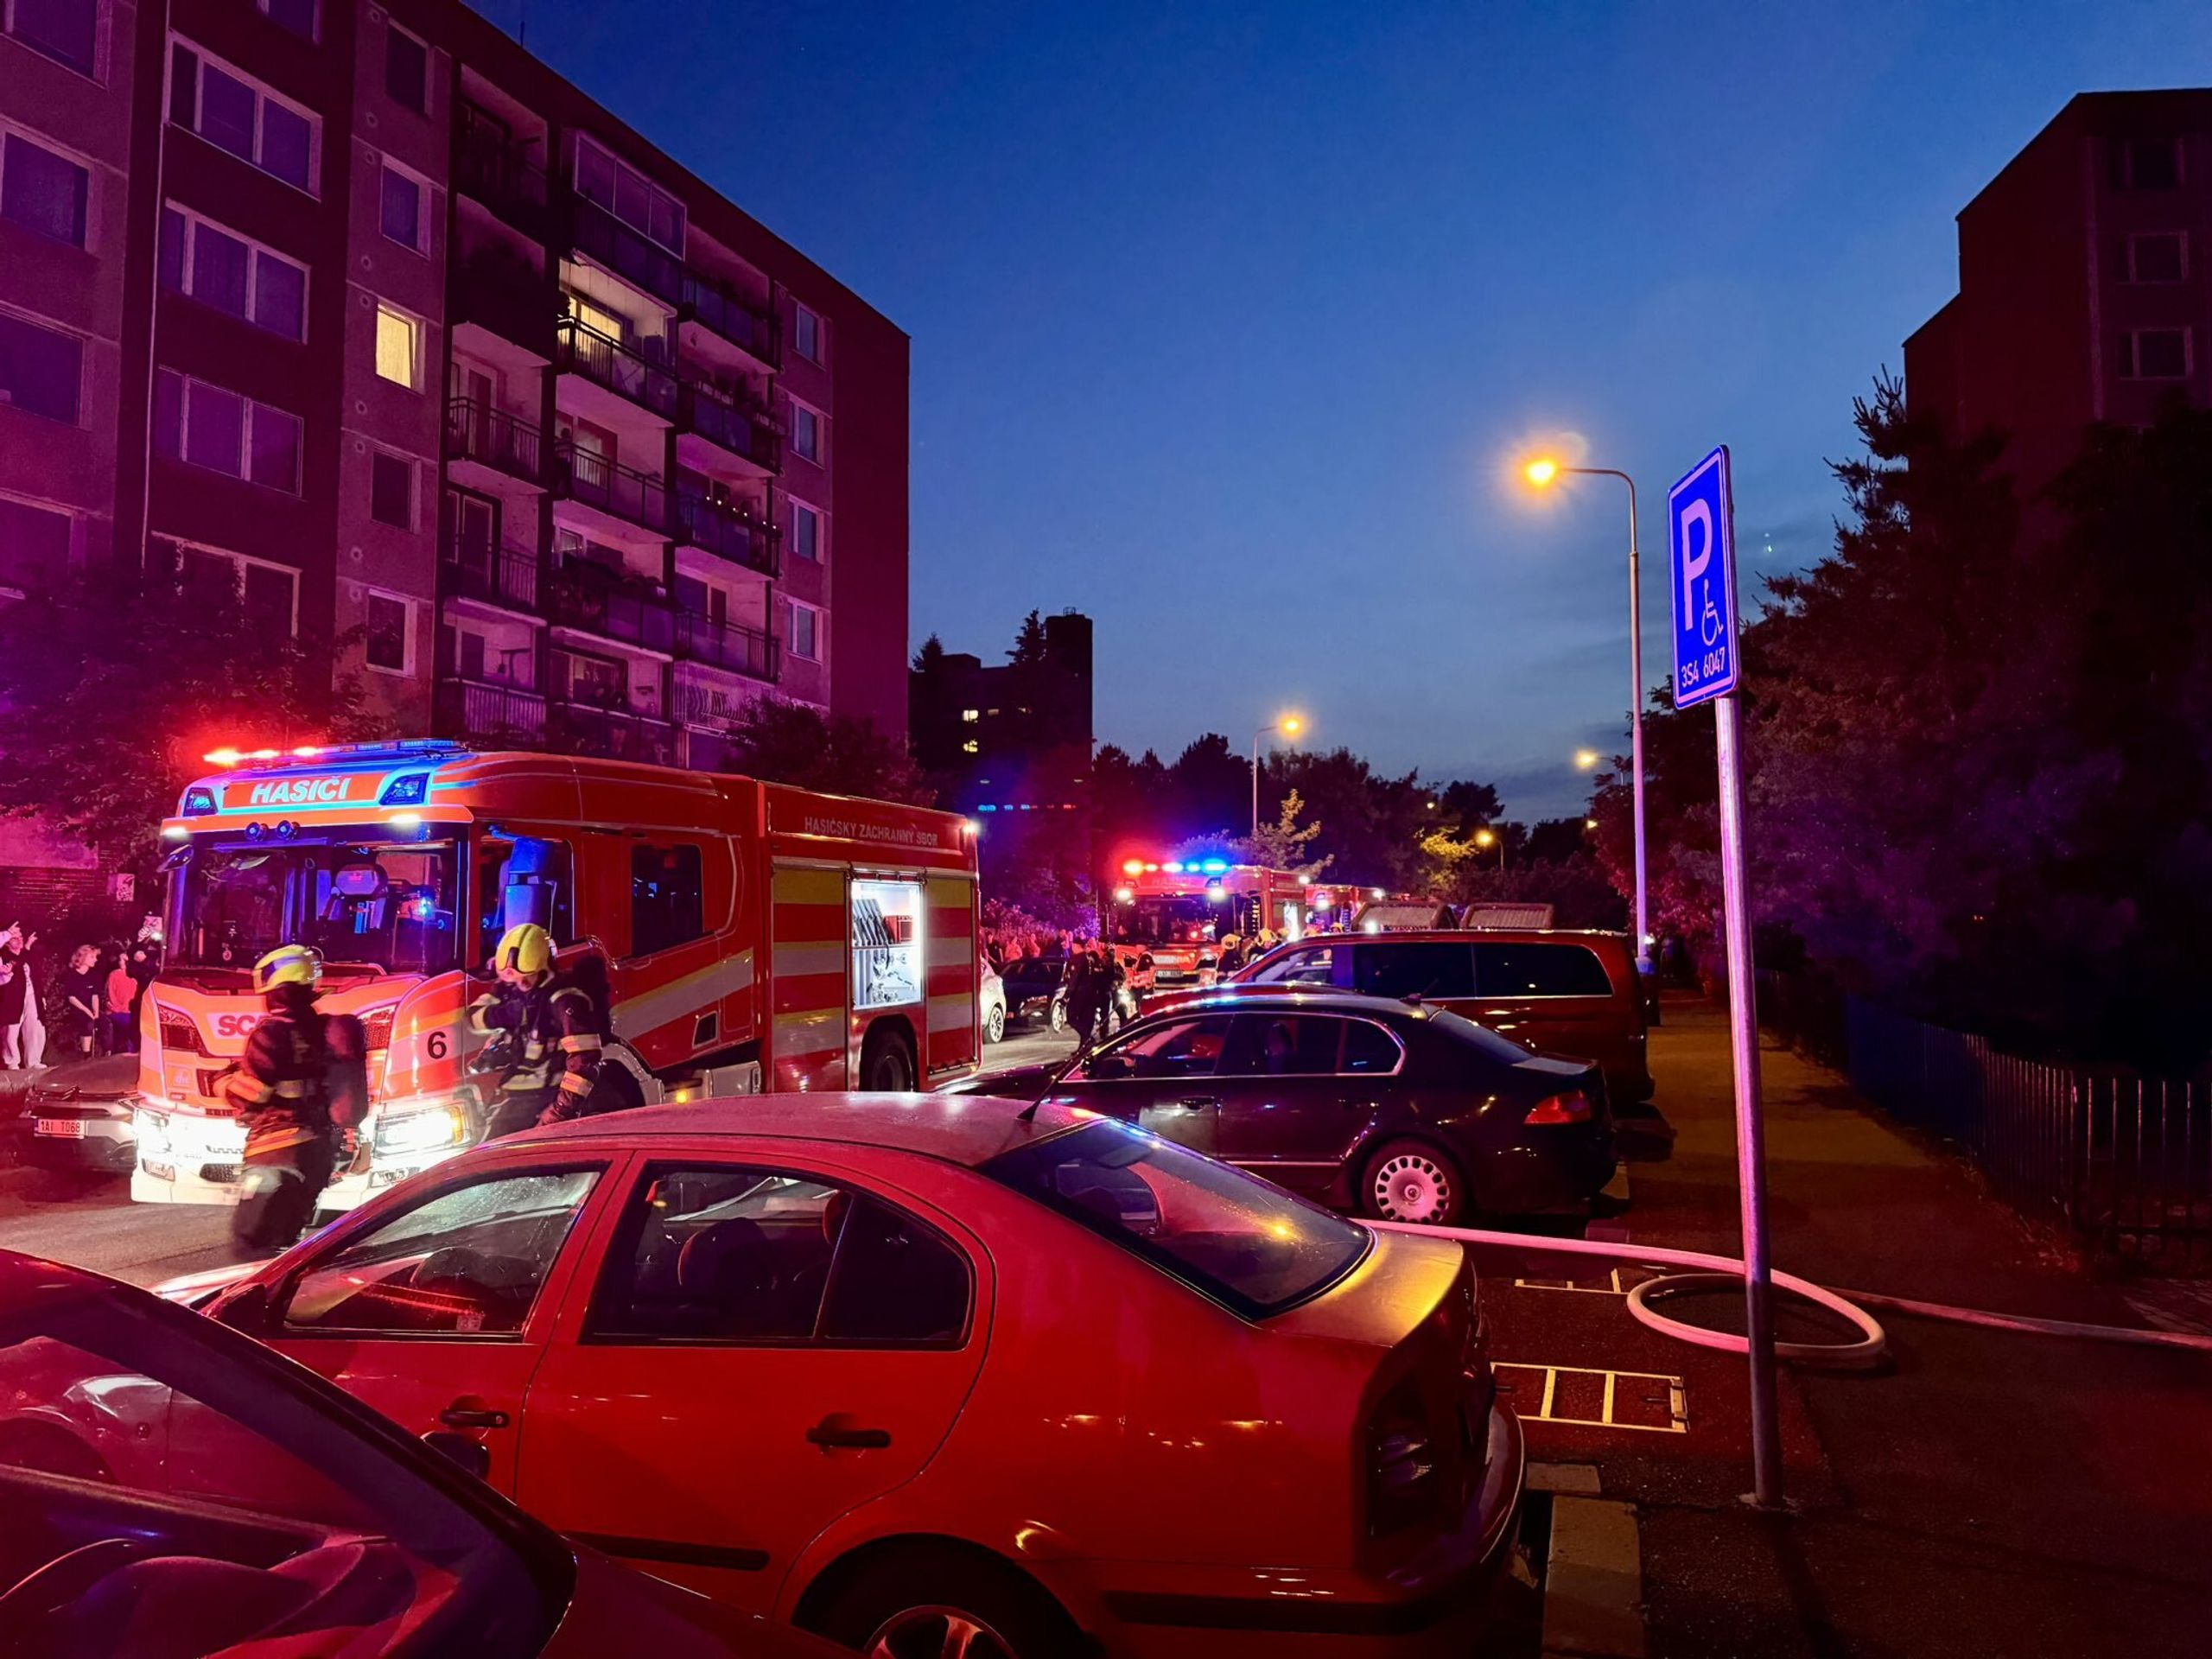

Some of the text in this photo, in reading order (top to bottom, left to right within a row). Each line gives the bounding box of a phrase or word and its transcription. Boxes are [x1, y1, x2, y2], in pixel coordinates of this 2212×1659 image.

[1681, 499, 1713, 631] P
[1681, 646, 1725, 688] 3S4 6047
[251, 775, 351, 804] HASIČI
[916, 831, 938, 846] SBOR
[428, 1031, 447, 1059] 6
